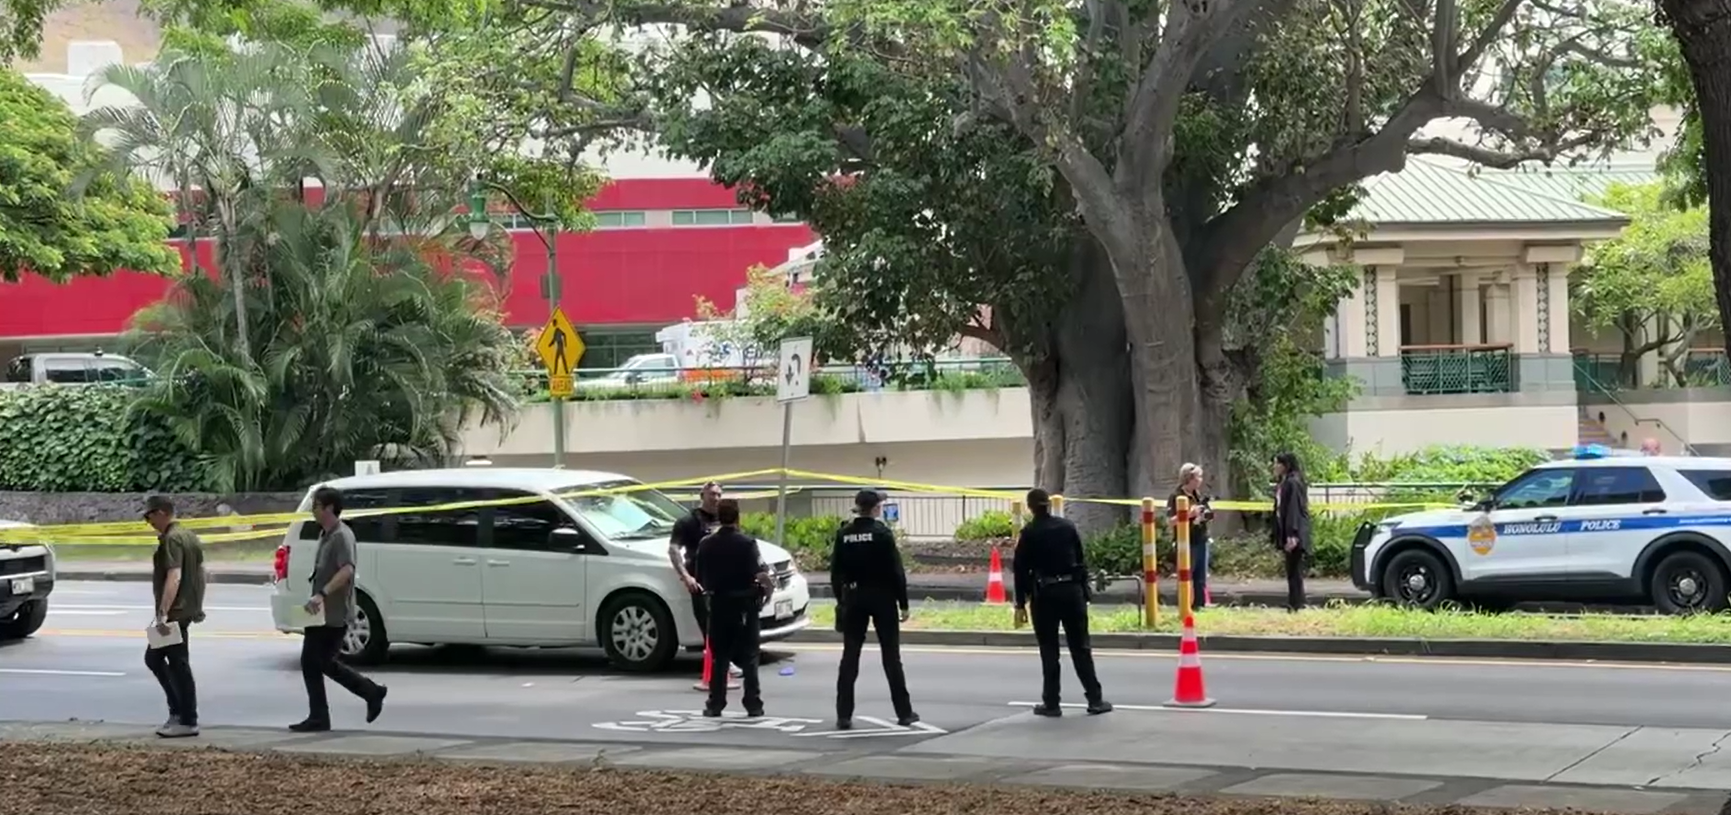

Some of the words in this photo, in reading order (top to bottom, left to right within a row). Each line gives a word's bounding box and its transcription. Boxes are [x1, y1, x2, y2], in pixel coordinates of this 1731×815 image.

[553, 379, 572, 391] AHEAD
[1503, 522, 1563, 535] HONOLULU
[1580, 519, 1622, 531] POLICE
[843, 532, 873, 543] POLICE
